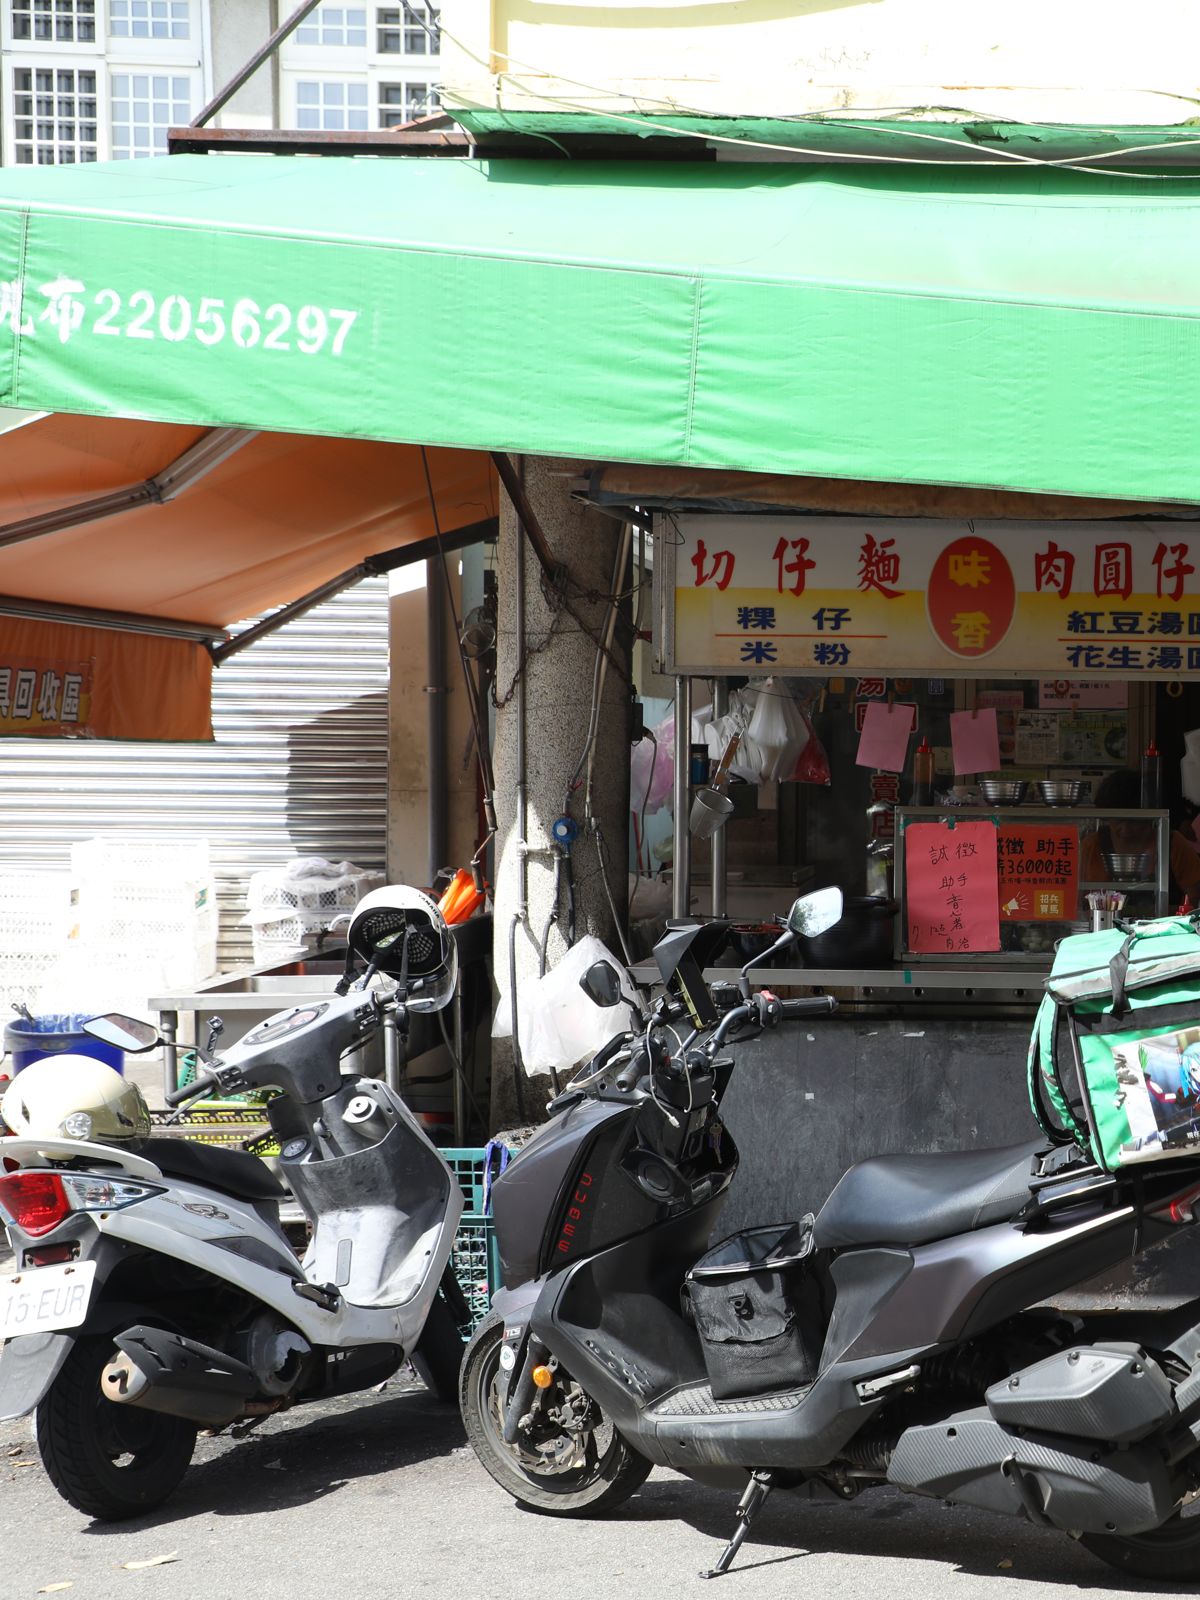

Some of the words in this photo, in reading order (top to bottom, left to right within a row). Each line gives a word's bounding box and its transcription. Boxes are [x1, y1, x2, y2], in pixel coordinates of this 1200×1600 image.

[690, 533, 904, 600] 切仔麵
[947, 548, 992, 649] 味香
[736, 606, 853, 632] 粿仔
[740, 640, 852, 667] 米粉
[928, 842, 979, 865] 誠徵
[1036, 838, 1075, 856] 助手
[938, 872, 968, 890] 助手
